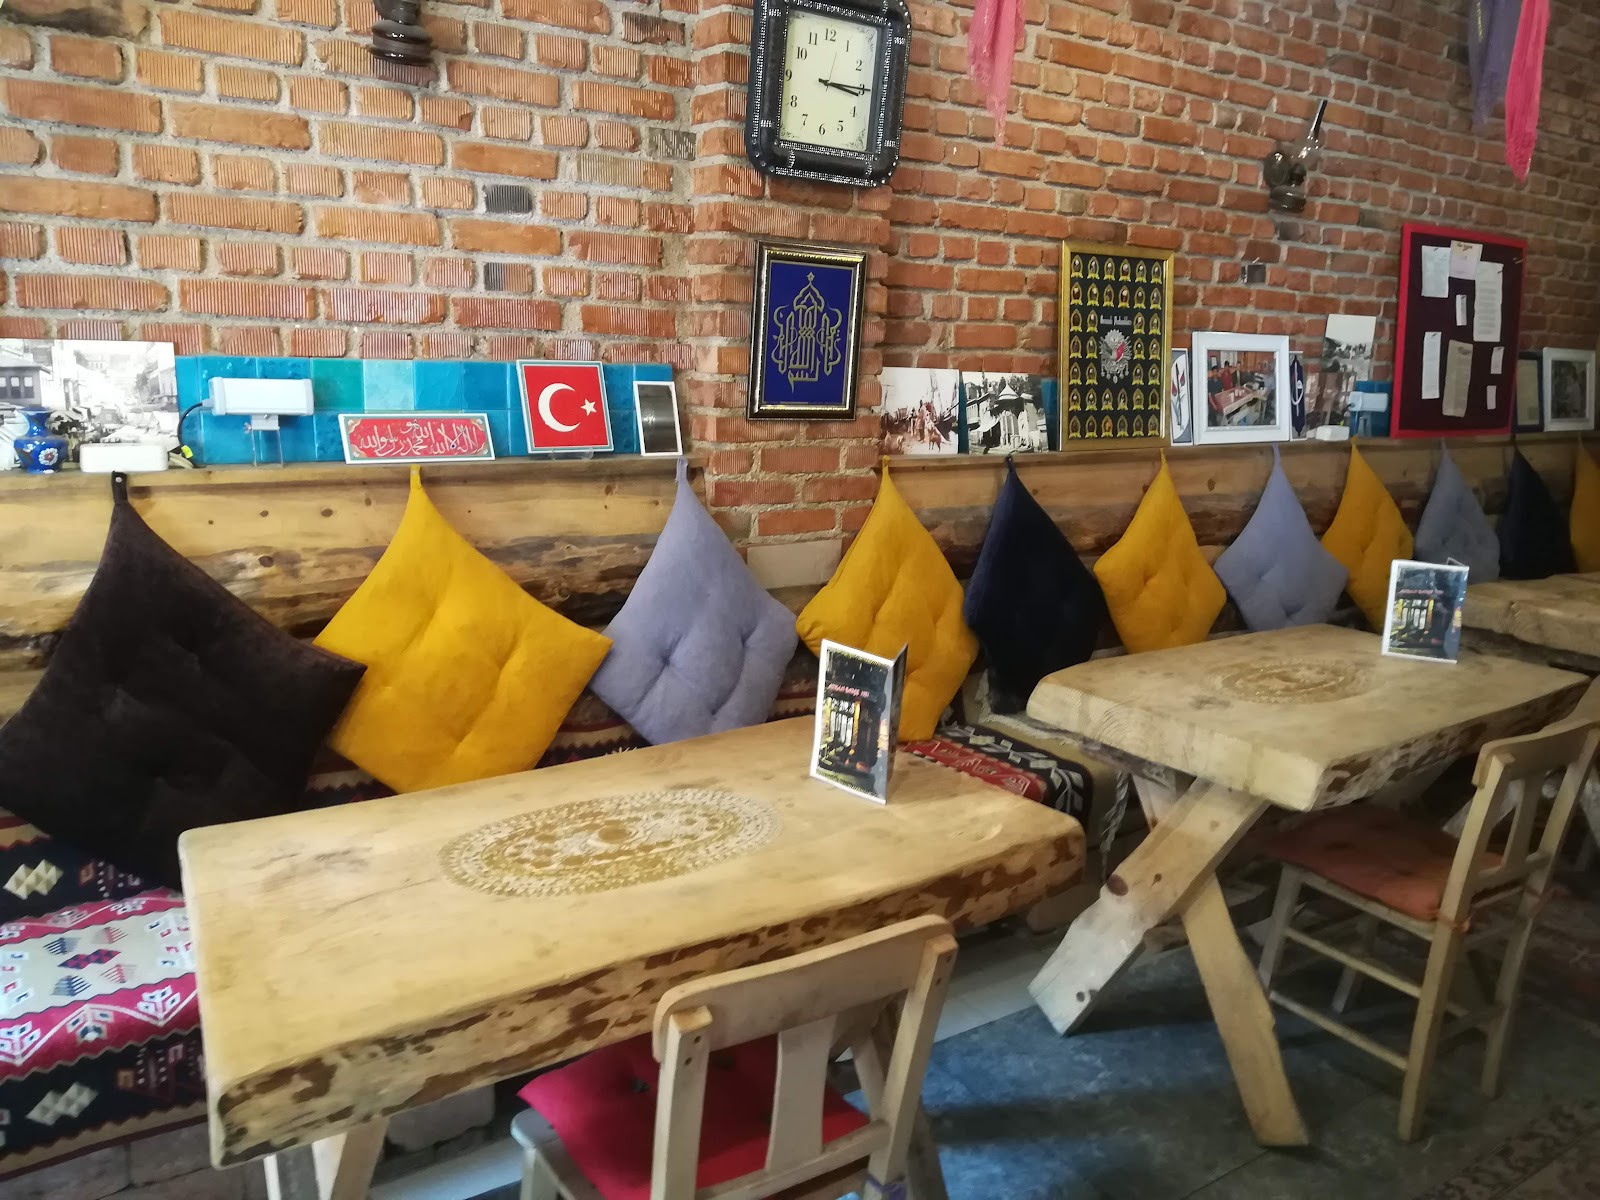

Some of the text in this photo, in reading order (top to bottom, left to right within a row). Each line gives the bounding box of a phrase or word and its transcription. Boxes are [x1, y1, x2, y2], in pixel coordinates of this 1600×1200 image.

[808, 32, 818, 46] 11
[825, 28, 836, 42] 12
[845, 40, 850, 52] 1
[796, 46, 808, 60] 10
[855, 59, 863, 71] 2
[785, 69, 793, 81] 9
[858, 83, 865, 96] 3
[790, 95, 798, 108] 8
[849, 106, 857, 118] 4
[801, 113, 808, 126] 7
[818, 123, 826, 135] 6
[836, 120, 844, 132] 5
